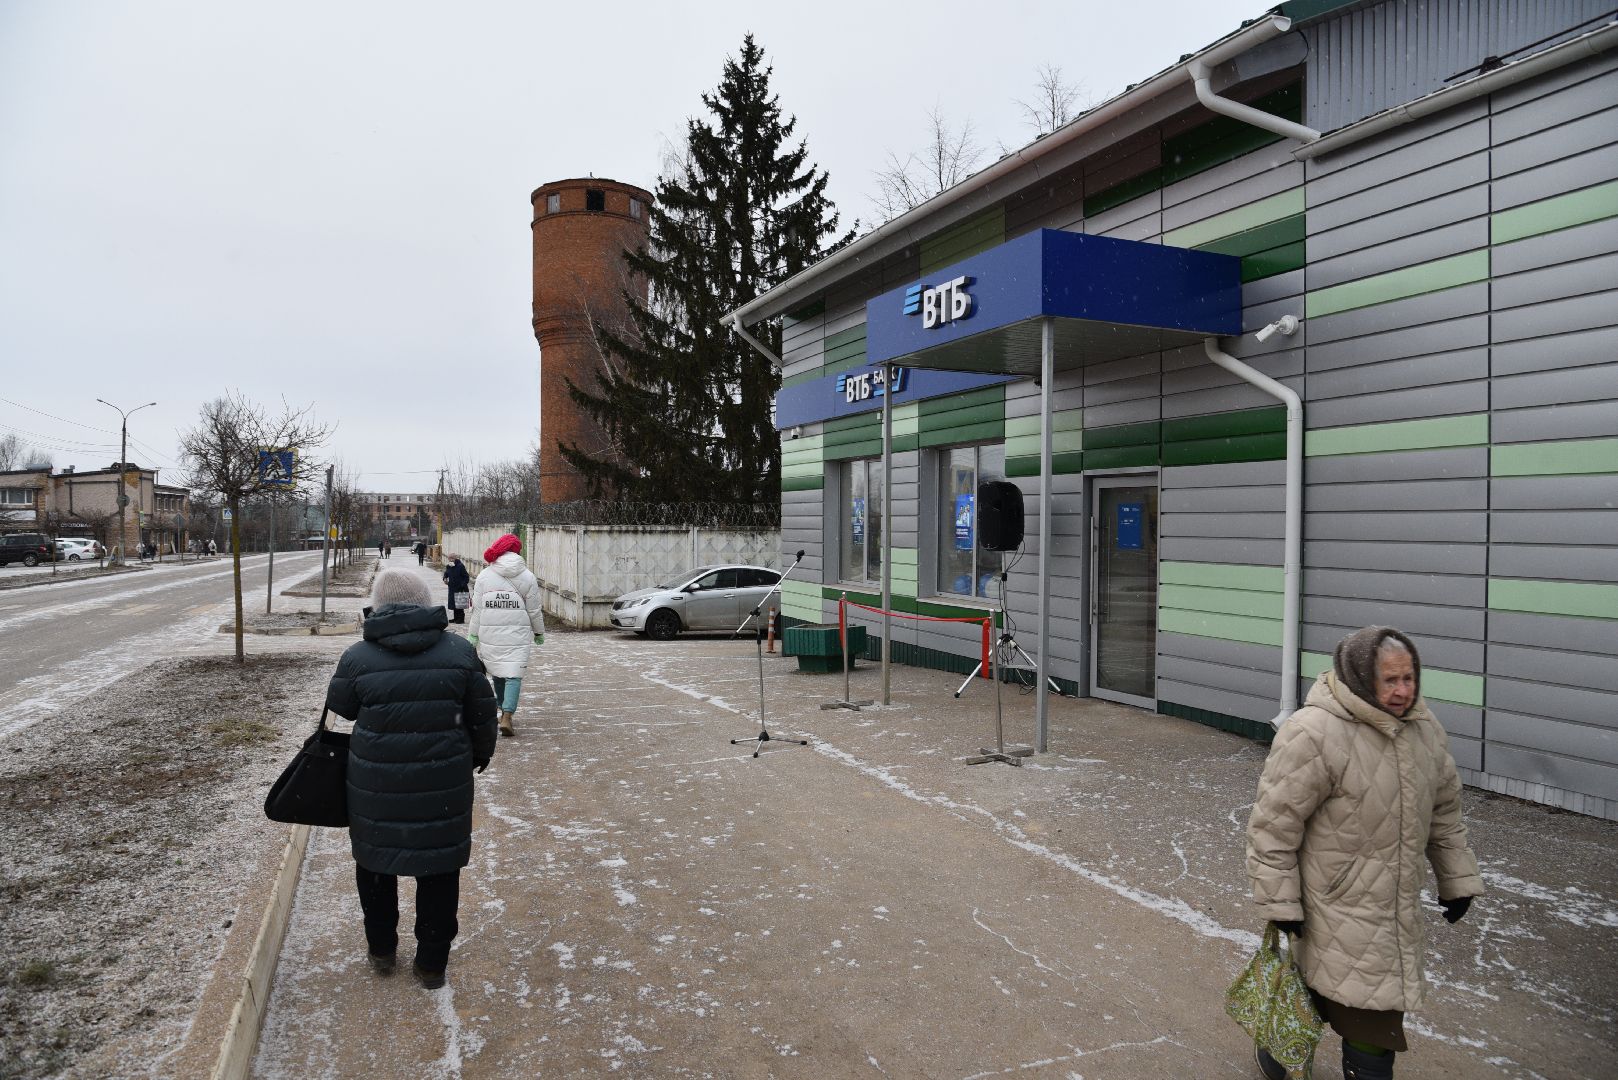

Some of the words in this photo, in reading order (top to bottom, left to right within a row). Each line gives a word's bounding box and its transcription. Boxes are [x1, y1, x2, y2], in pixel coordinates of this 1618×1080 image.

[922, 275, 970, 328] ВТБ
[846, 373, 870, 403] ВТБ
[485, 601, 520, 609] BEAUTIFUL
